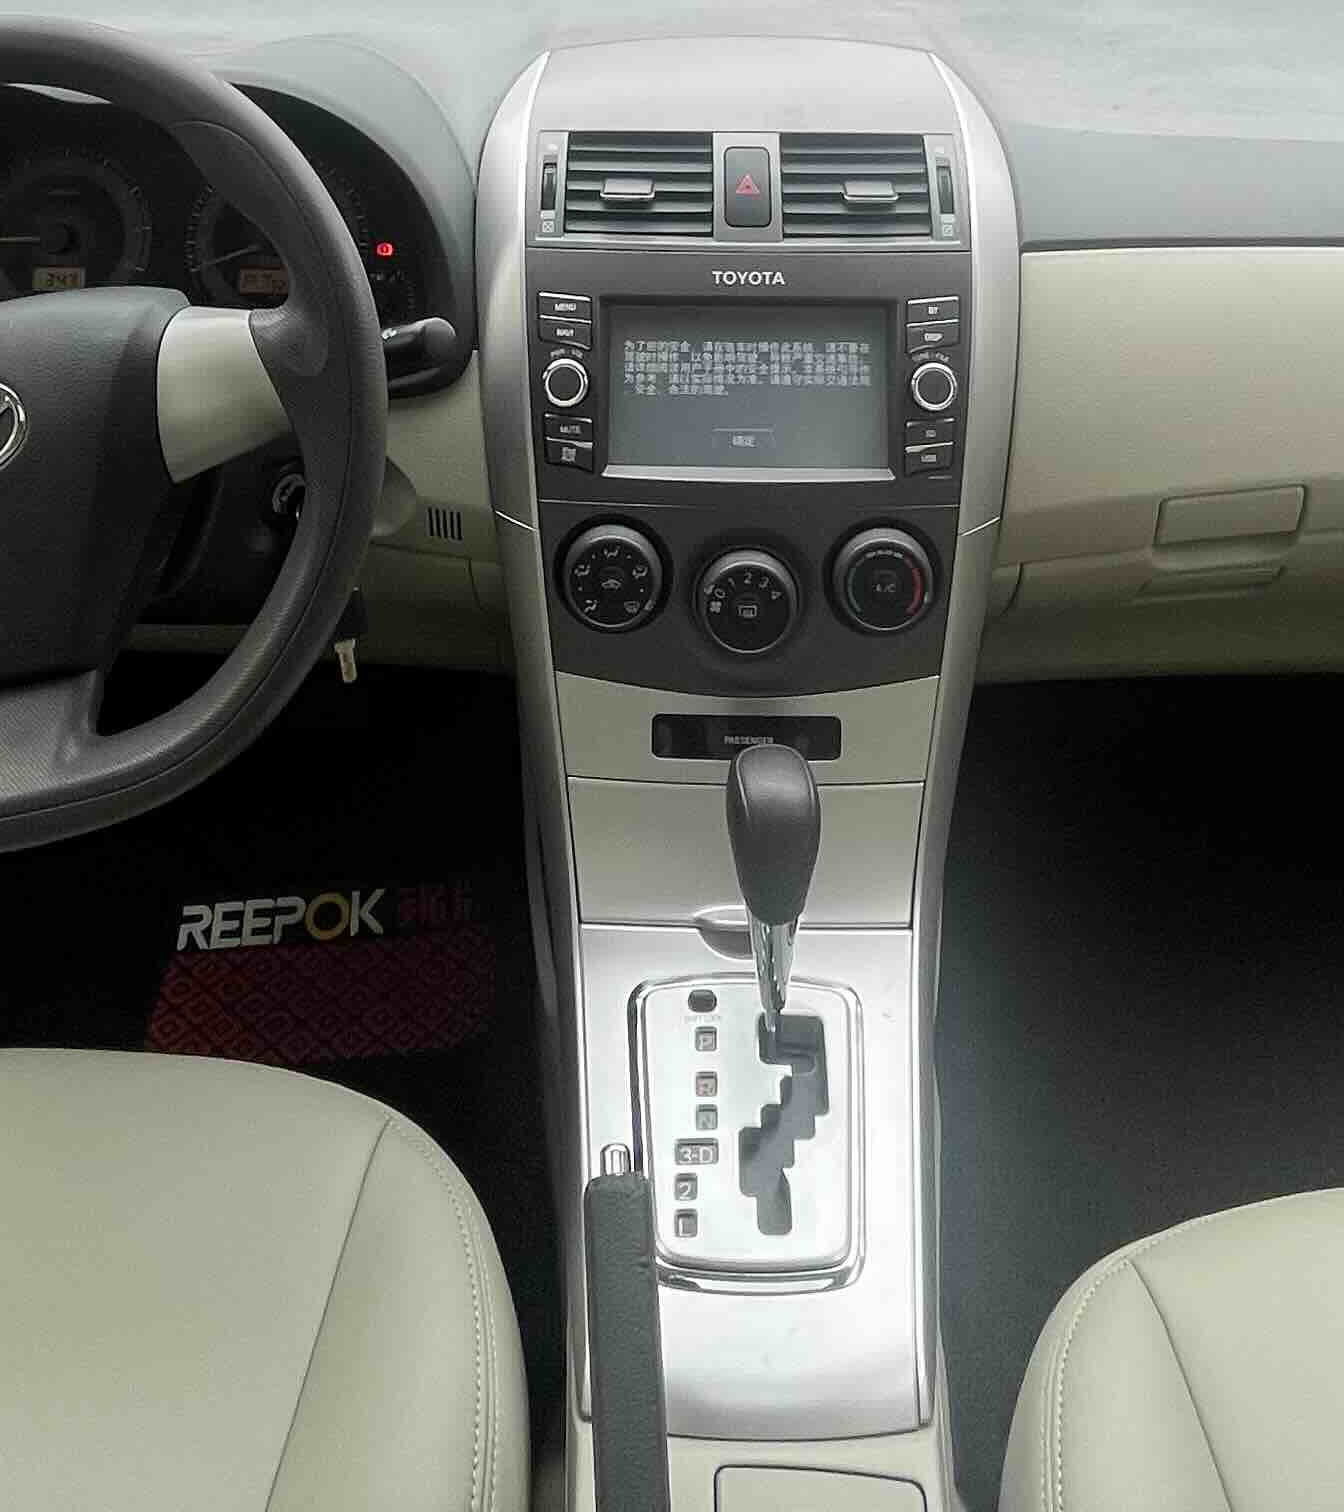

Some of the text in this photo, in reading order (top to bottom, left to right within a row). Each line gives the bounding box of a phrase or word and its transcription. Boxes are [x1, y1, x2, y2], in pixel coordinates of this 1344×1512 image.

[712, 270, 785, 285] TOYOTA
[176, 888, 385, 952] REEPOK
[698, 1032, 715, 1050] P
[679, 1146, 714, 1164] 3-D
[679, 1181, 692, 1200] 2
[678, 1217, 695, 1237] L
